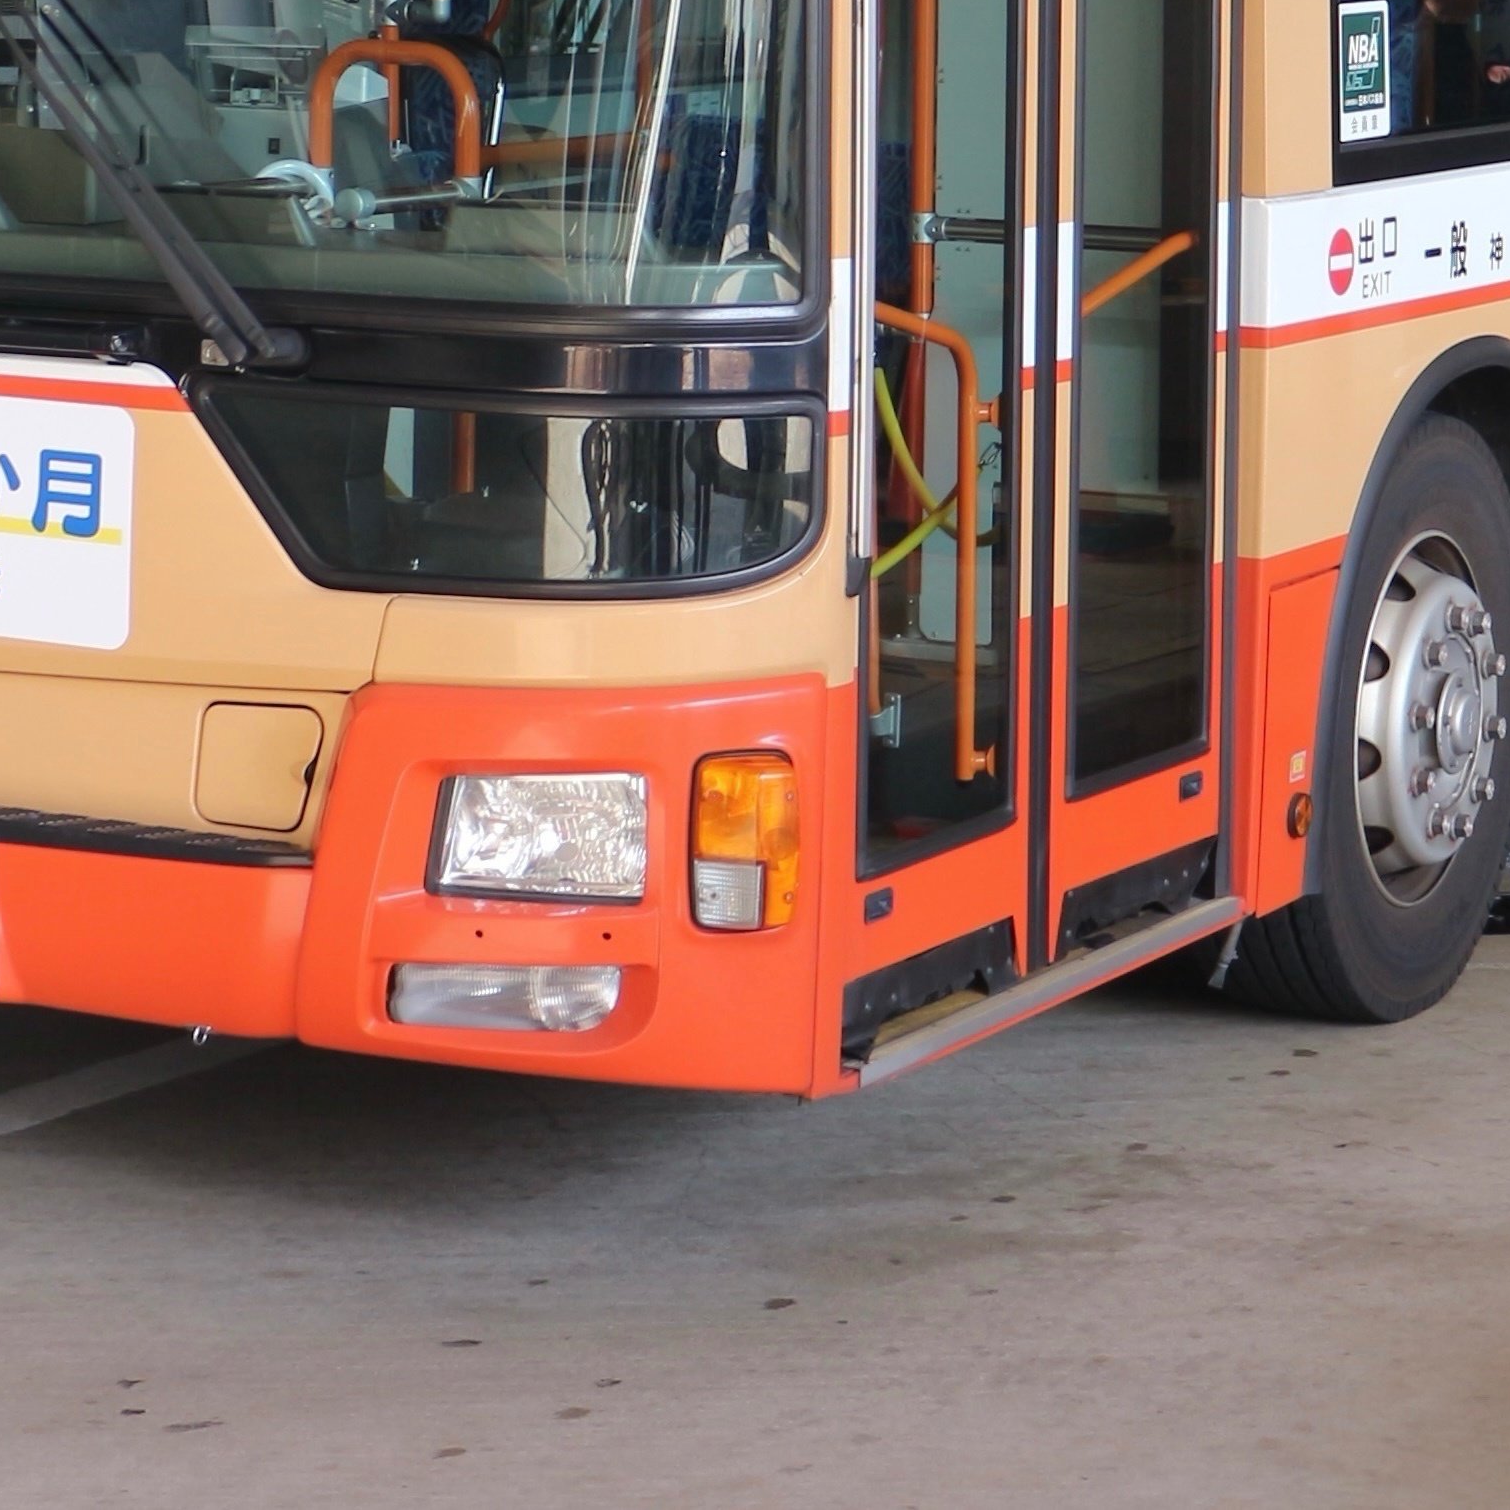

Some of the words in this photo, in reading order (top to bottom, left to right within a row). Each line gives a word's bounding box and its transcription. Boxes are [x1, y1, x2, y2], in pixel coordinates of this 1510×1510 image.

[1348, 32, 1379, 65] NBA
[1358, 216, 1397, 264] 出口
[1362, 271, 1392, 299] EXIT
